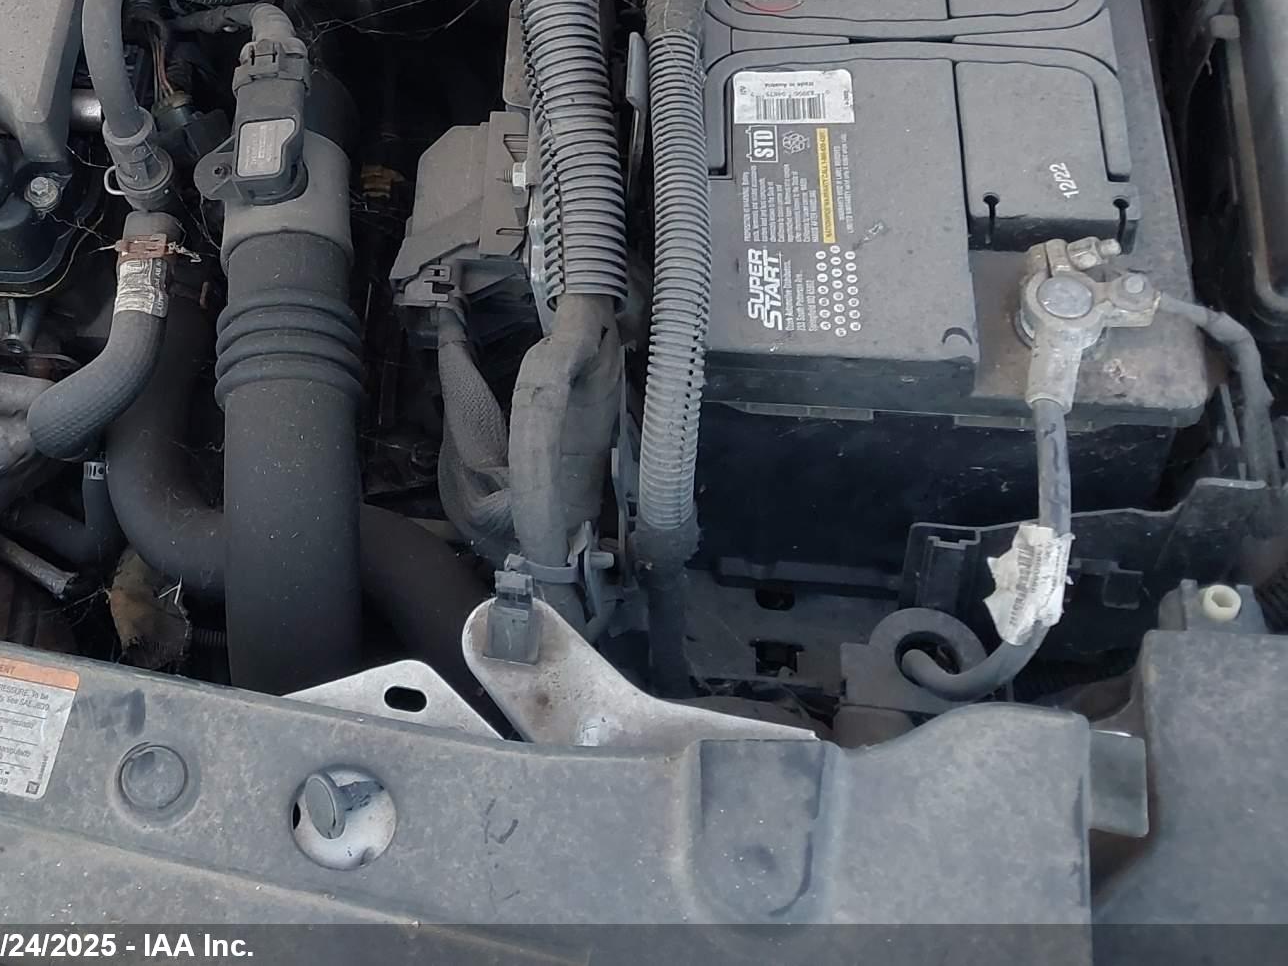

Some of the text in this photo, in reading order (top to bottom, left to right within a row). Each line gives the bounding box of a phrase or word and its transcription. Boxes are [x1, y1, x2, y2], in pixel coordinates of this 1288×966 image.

[753, 130, 774, 158] STD
[1049, 163, 1079, 198] 12/22
[748, 248, 765, 320] SUPER
[763, 249, 782, 330] START
[784, 290, 793, 316] Automotive
